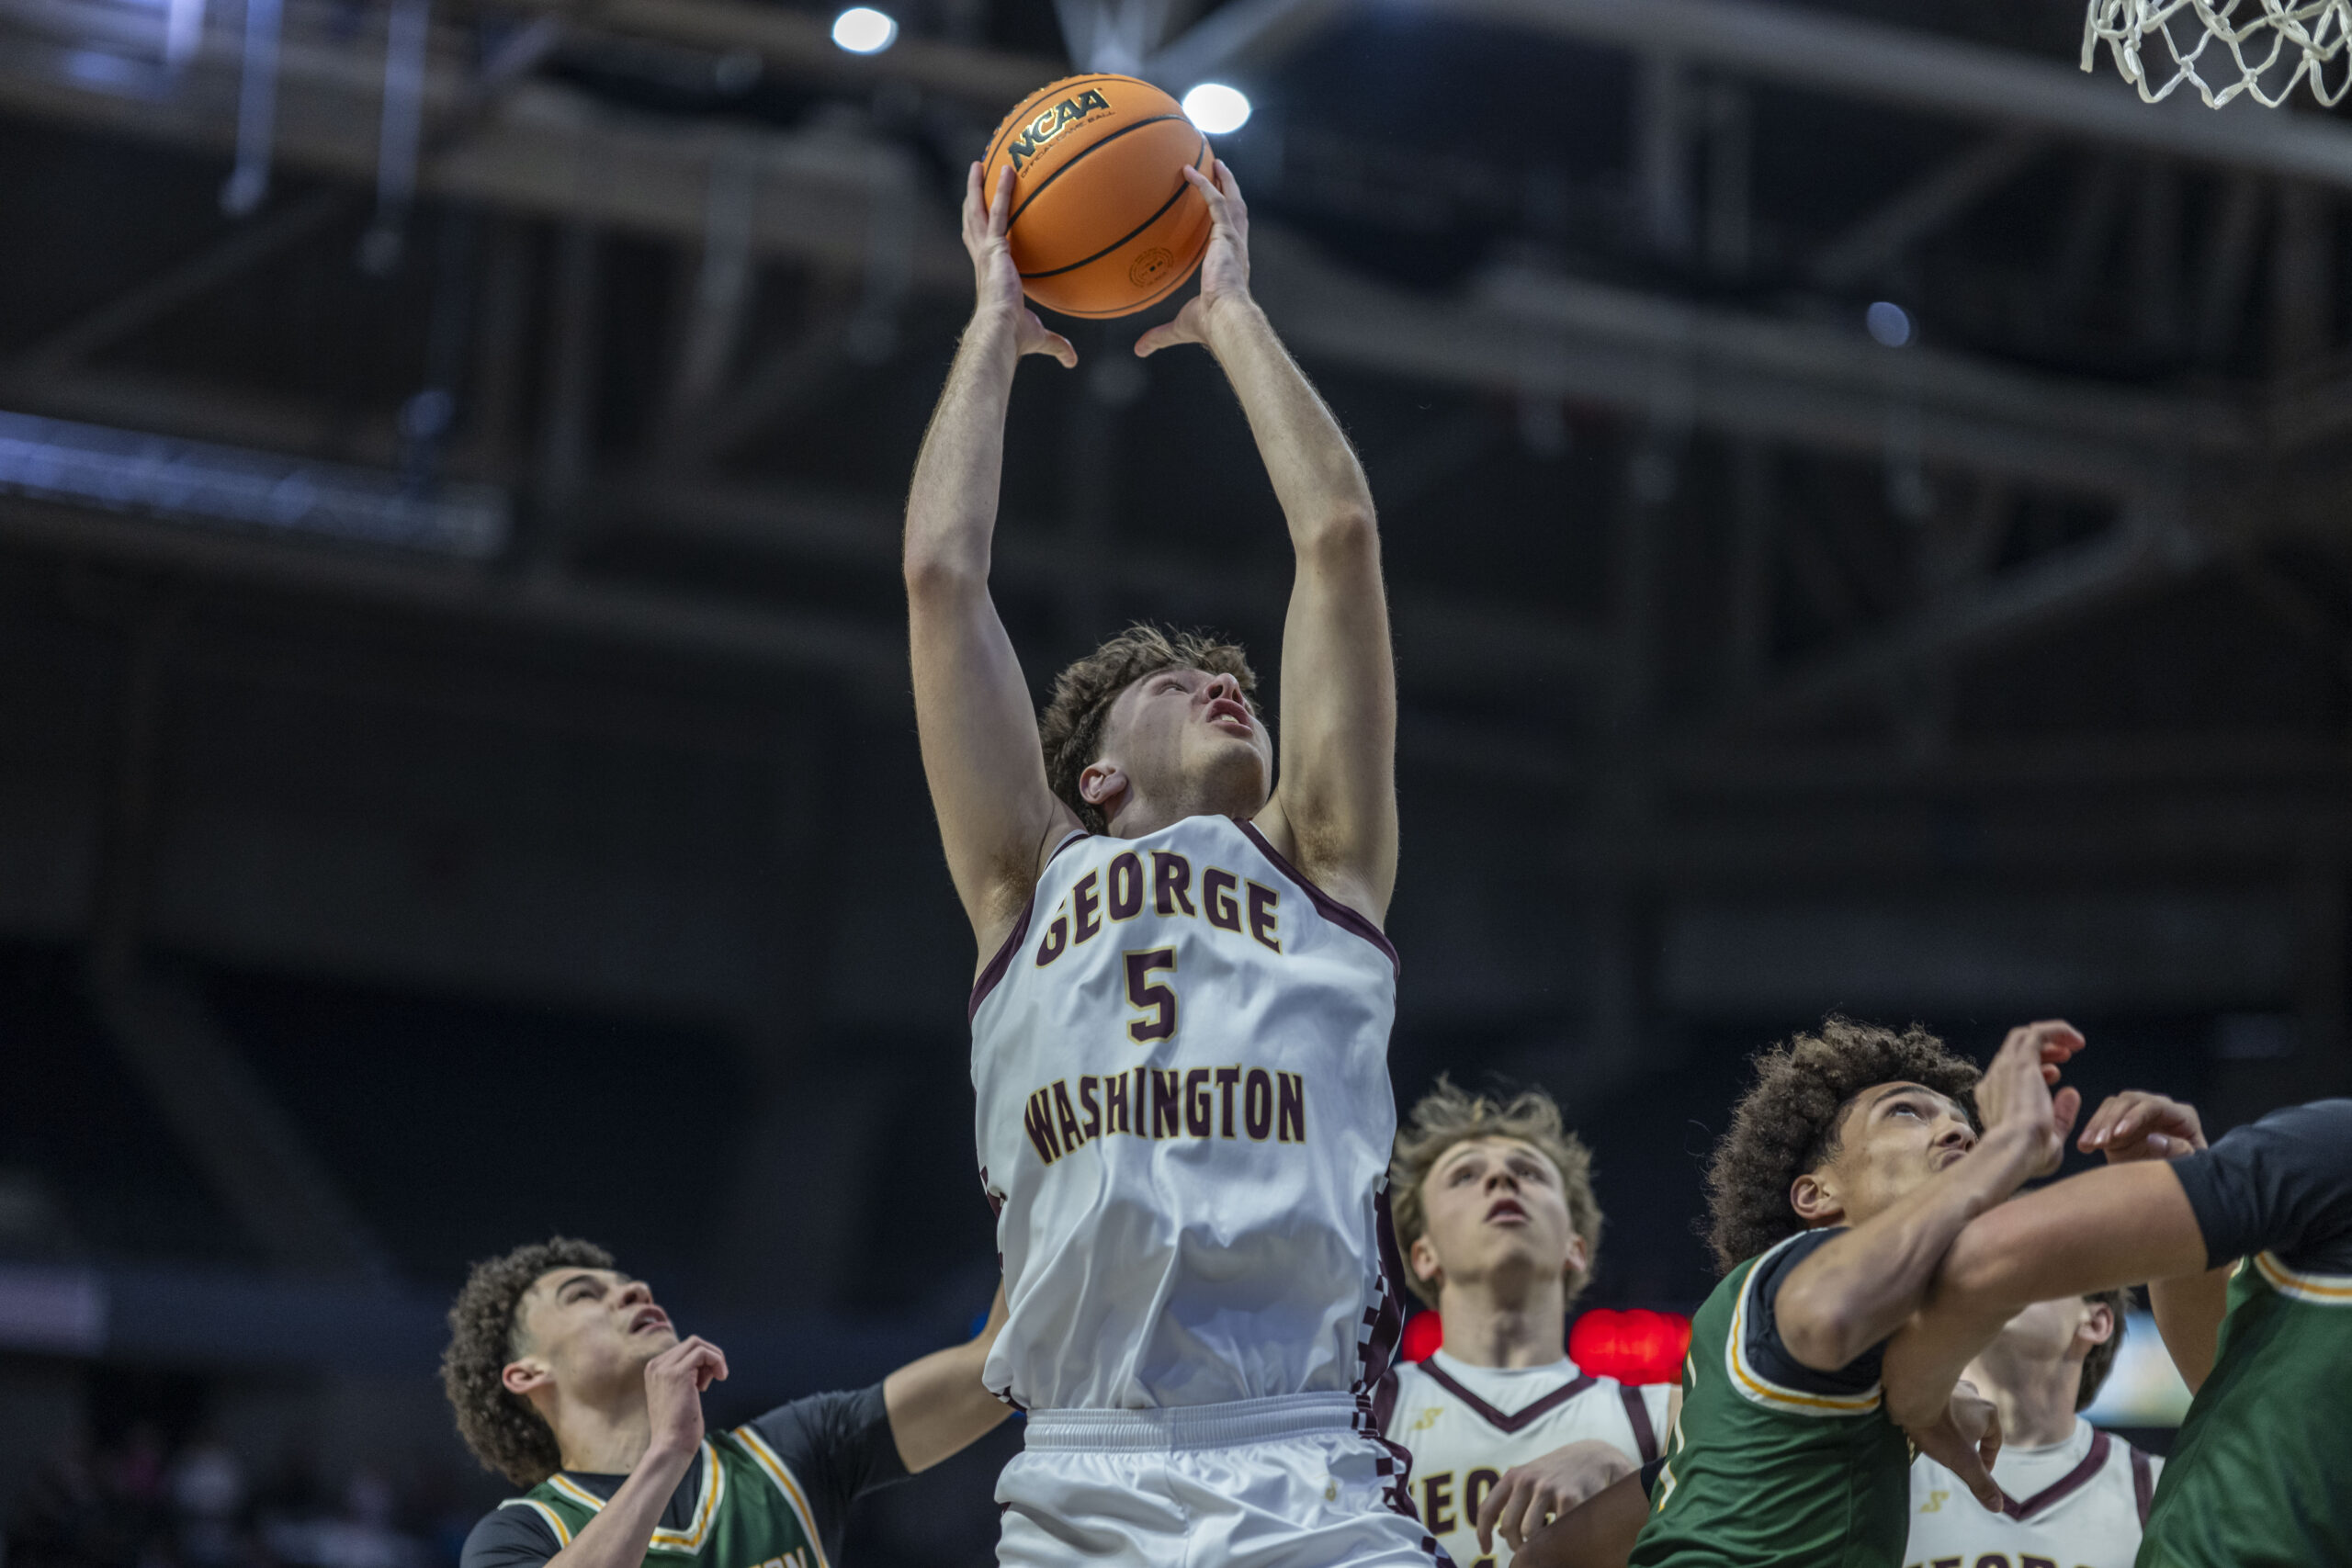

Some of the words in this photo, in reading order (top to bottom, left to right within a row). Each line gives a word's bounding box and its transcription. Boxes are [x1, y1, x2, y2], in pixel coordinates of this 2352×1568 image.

[1008, 88, 1112, 173] NCAA
[1087, 110, 1116, 124] BALL
[1035, 849, 1283, 969] GEORGE
[1123, 945, 1179, 1045] 5
[1023, 1063, 1307, 1167] WASHINGTON
